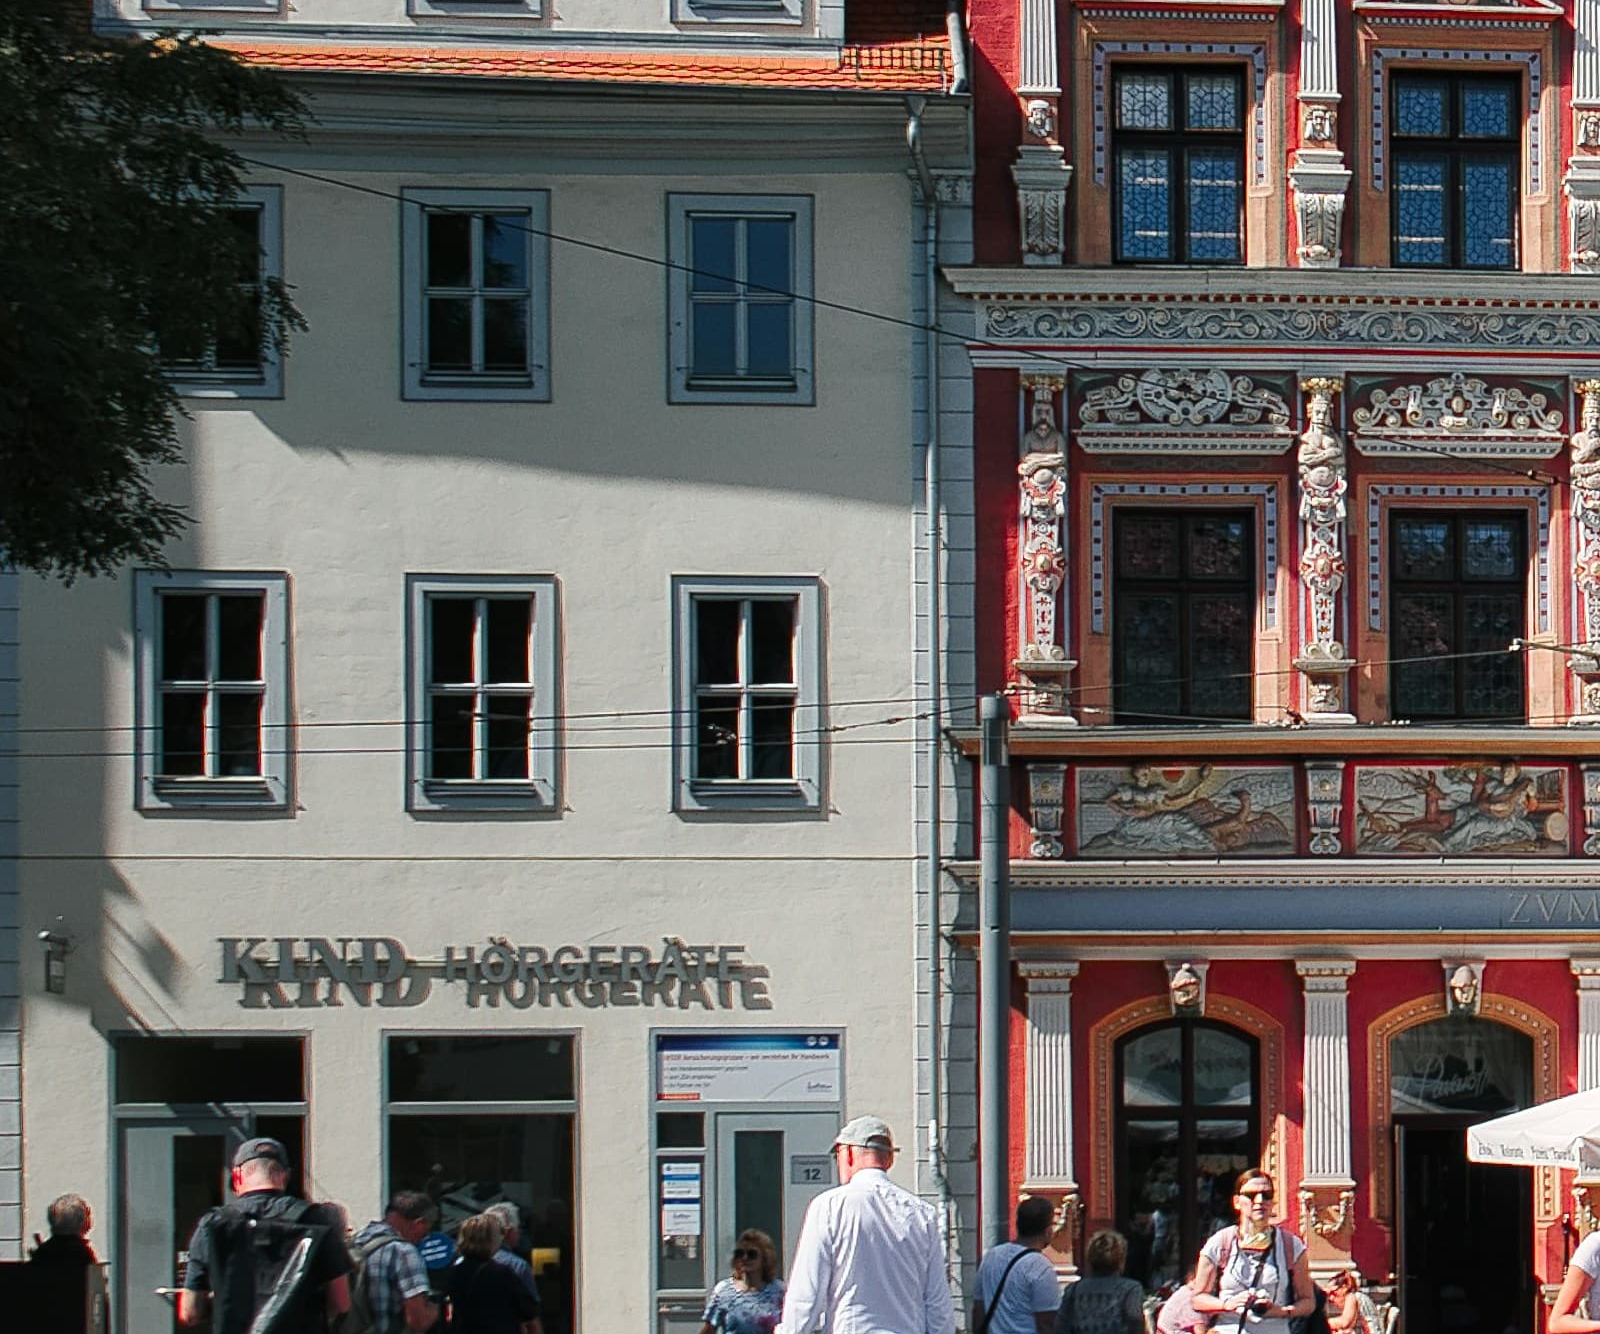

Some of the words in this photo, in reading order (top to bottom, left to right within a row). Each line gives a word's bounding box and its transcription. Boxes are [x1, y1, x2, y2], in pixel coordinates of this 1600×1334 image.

[1508, 891, 1600, 923] ZVM
[217, 937, 407, 984] KIND
[445, 936, 746, 984] HÖRGERÄTE
[803, 1168, 821, 1181] 12
